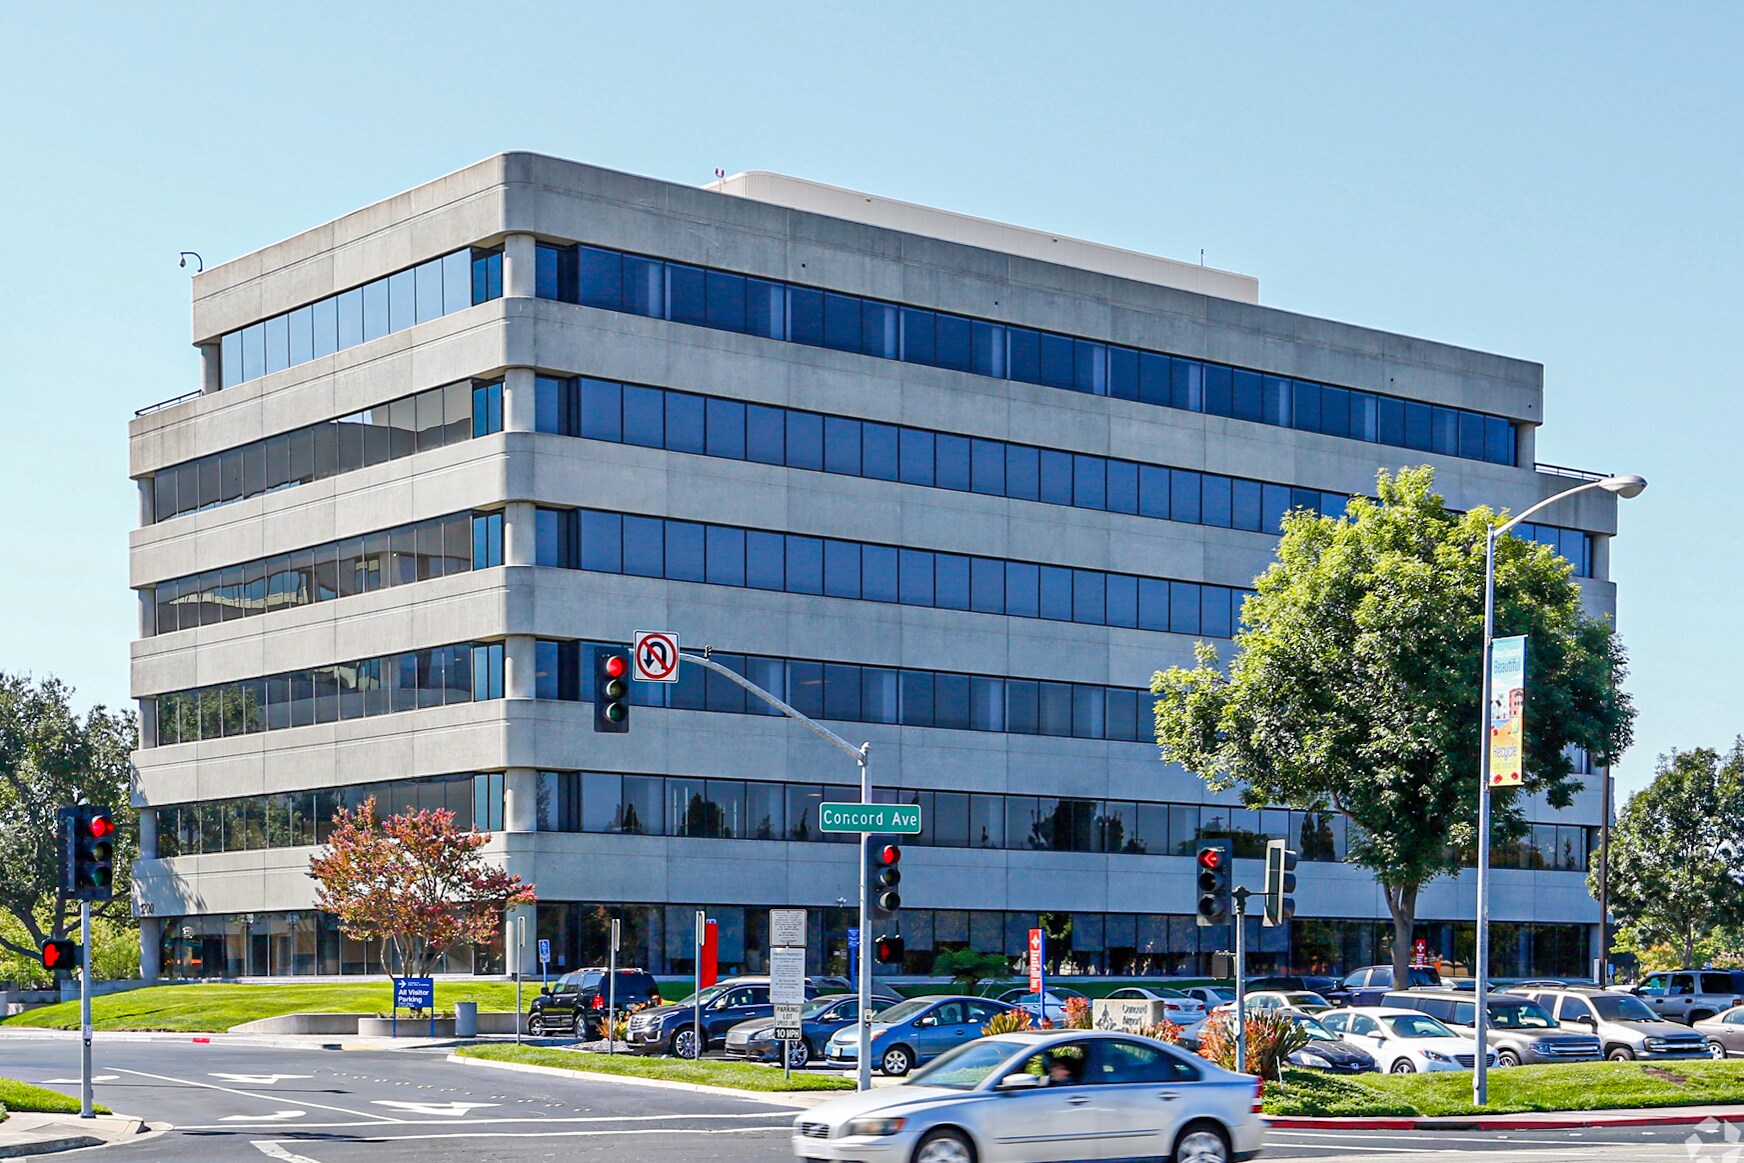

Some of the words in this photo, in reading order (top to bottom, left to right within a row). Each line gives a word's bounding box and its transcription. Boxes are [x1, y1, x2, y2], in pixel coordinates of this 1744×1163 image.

[1494, 657, 1521, 673] Beautiful
[1493, 744, 1517, 761] Recycle
[823, 809, 883, 826] Concord
[891, 811, 917, 826] Ave
[398, 996, 423, 1004] Parking
[1122, 1004, 1148, 1014] Concord
[776, 1029, 786, 1038] 10
[786, 1029, 799, 1038] MPH
